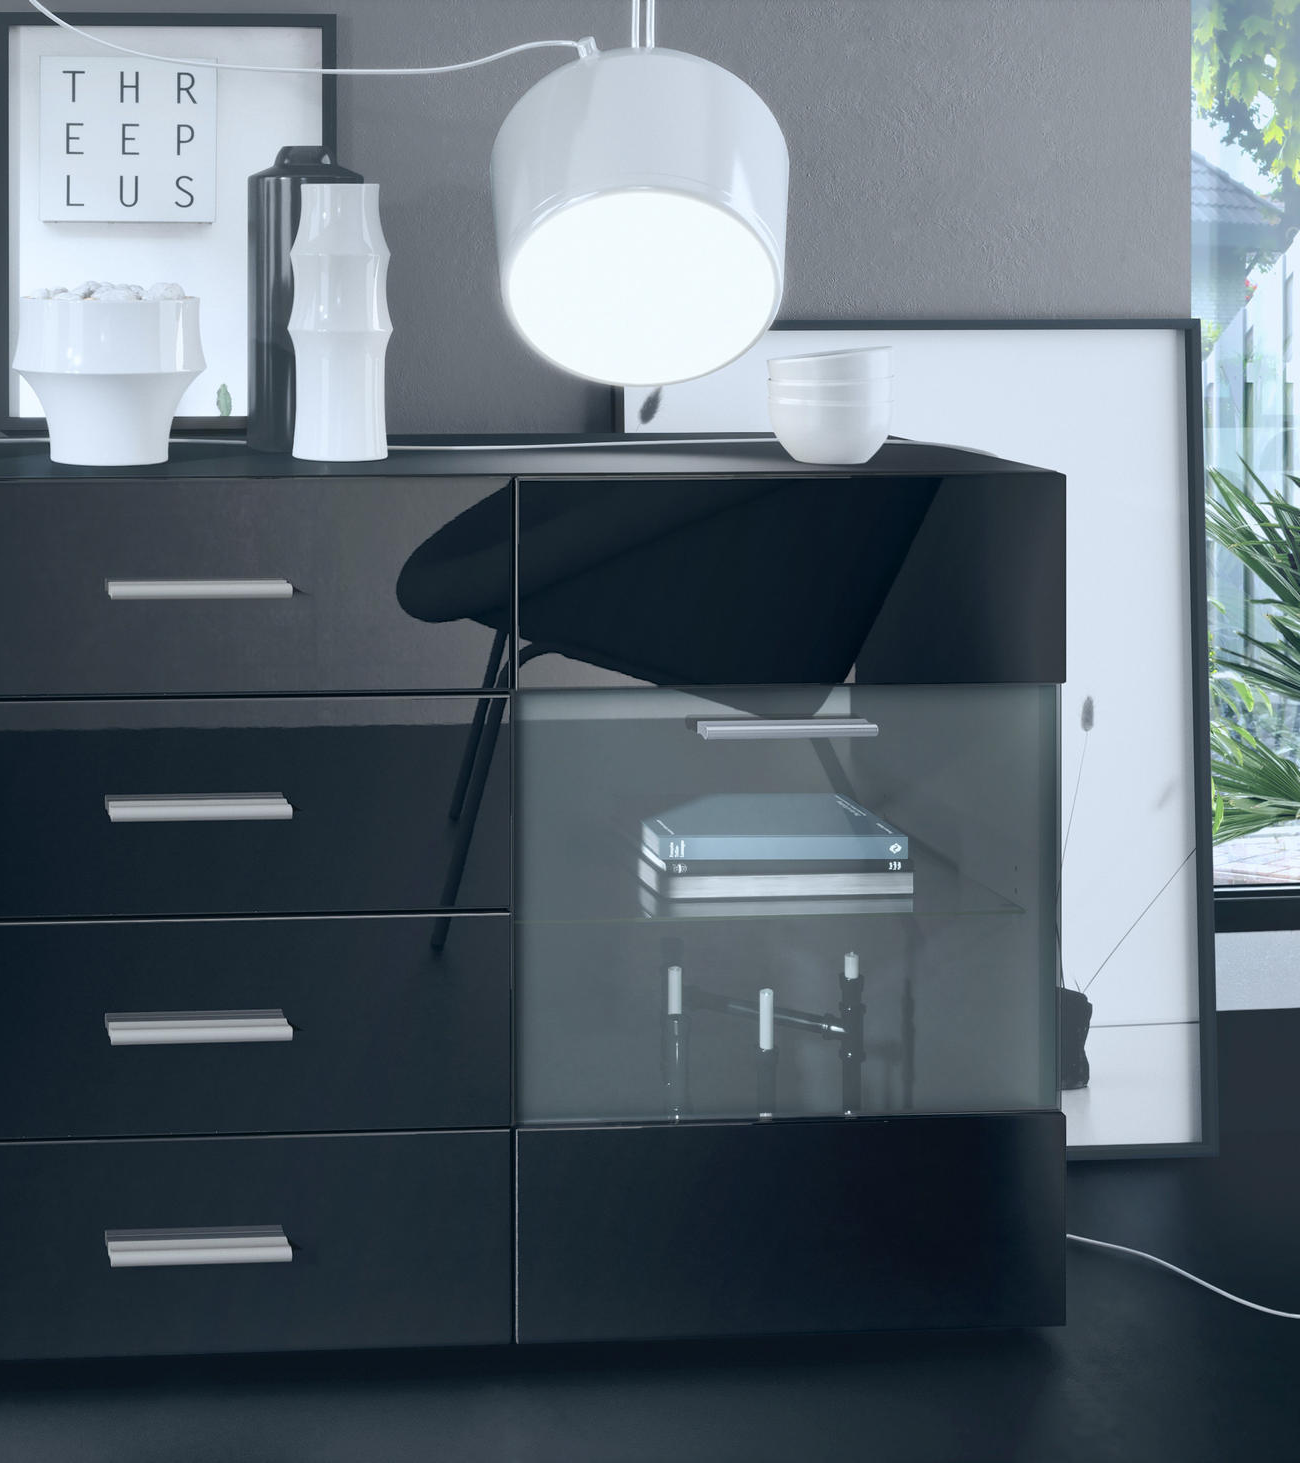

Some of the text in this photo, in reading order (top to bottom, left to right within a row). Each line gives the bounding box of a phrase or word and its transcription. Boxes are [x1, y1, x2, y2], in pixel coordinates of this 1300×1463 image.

[62, 70, 198, 104] THR
[65, 122, 195, 156] EEP
[65, 174, 194, 208] LUS
